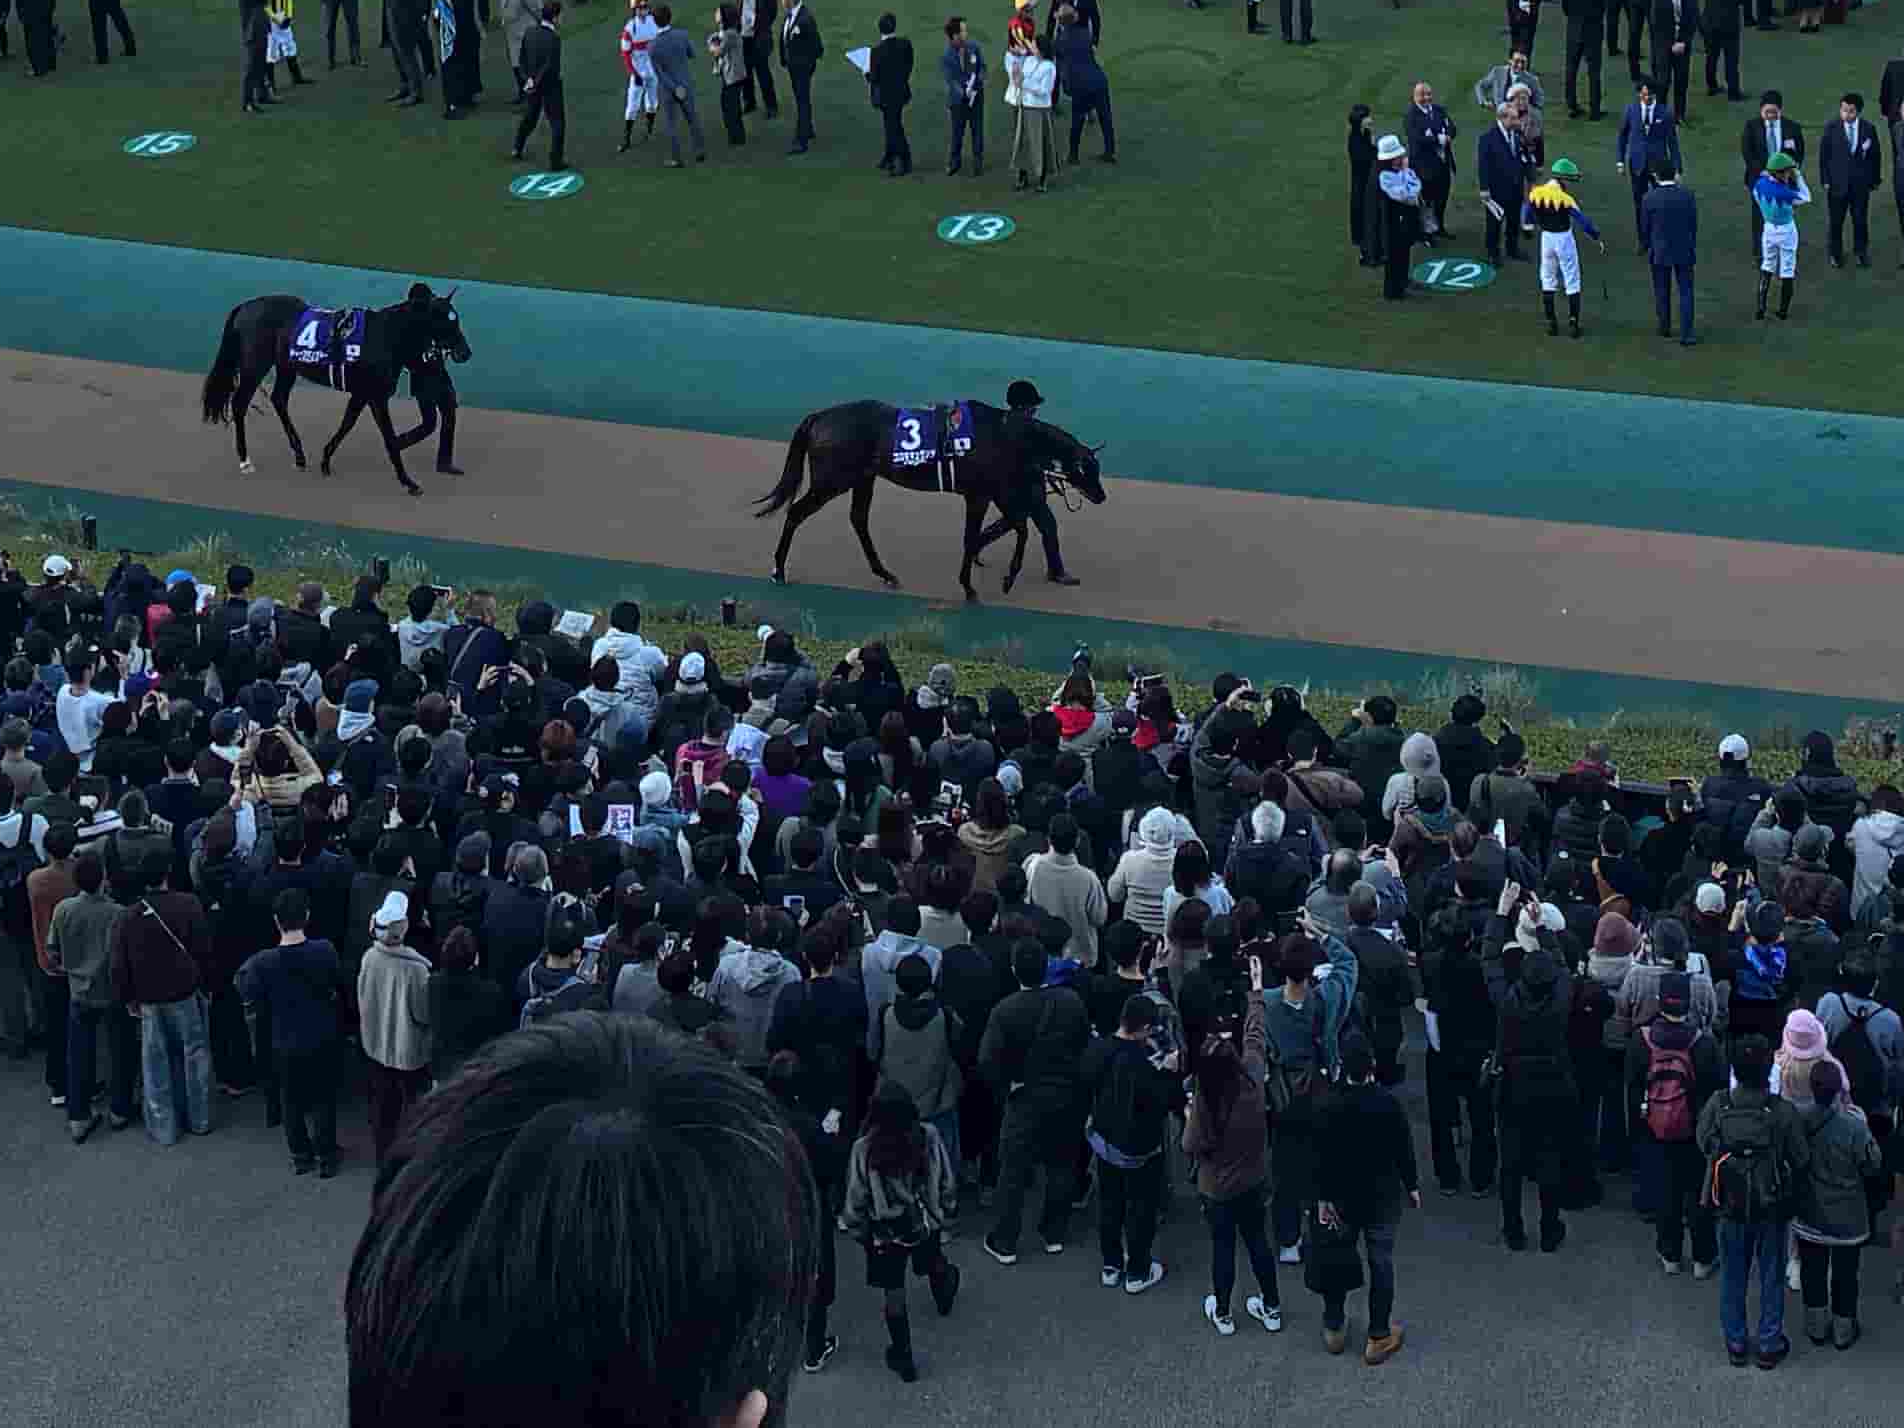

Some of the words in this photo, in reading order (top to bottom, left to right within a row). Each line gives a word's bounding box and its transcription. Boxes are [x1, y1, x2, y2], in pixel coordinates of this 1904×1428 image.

[129, 133, 192, 154] 15
[513, 174, 573, 196] 14
[947, 215, 1006, 240] 13
[1425, 261, 1483, 287] 12
[297, 320, 321, 349] 4
[900, 418, 921, 451] 3
